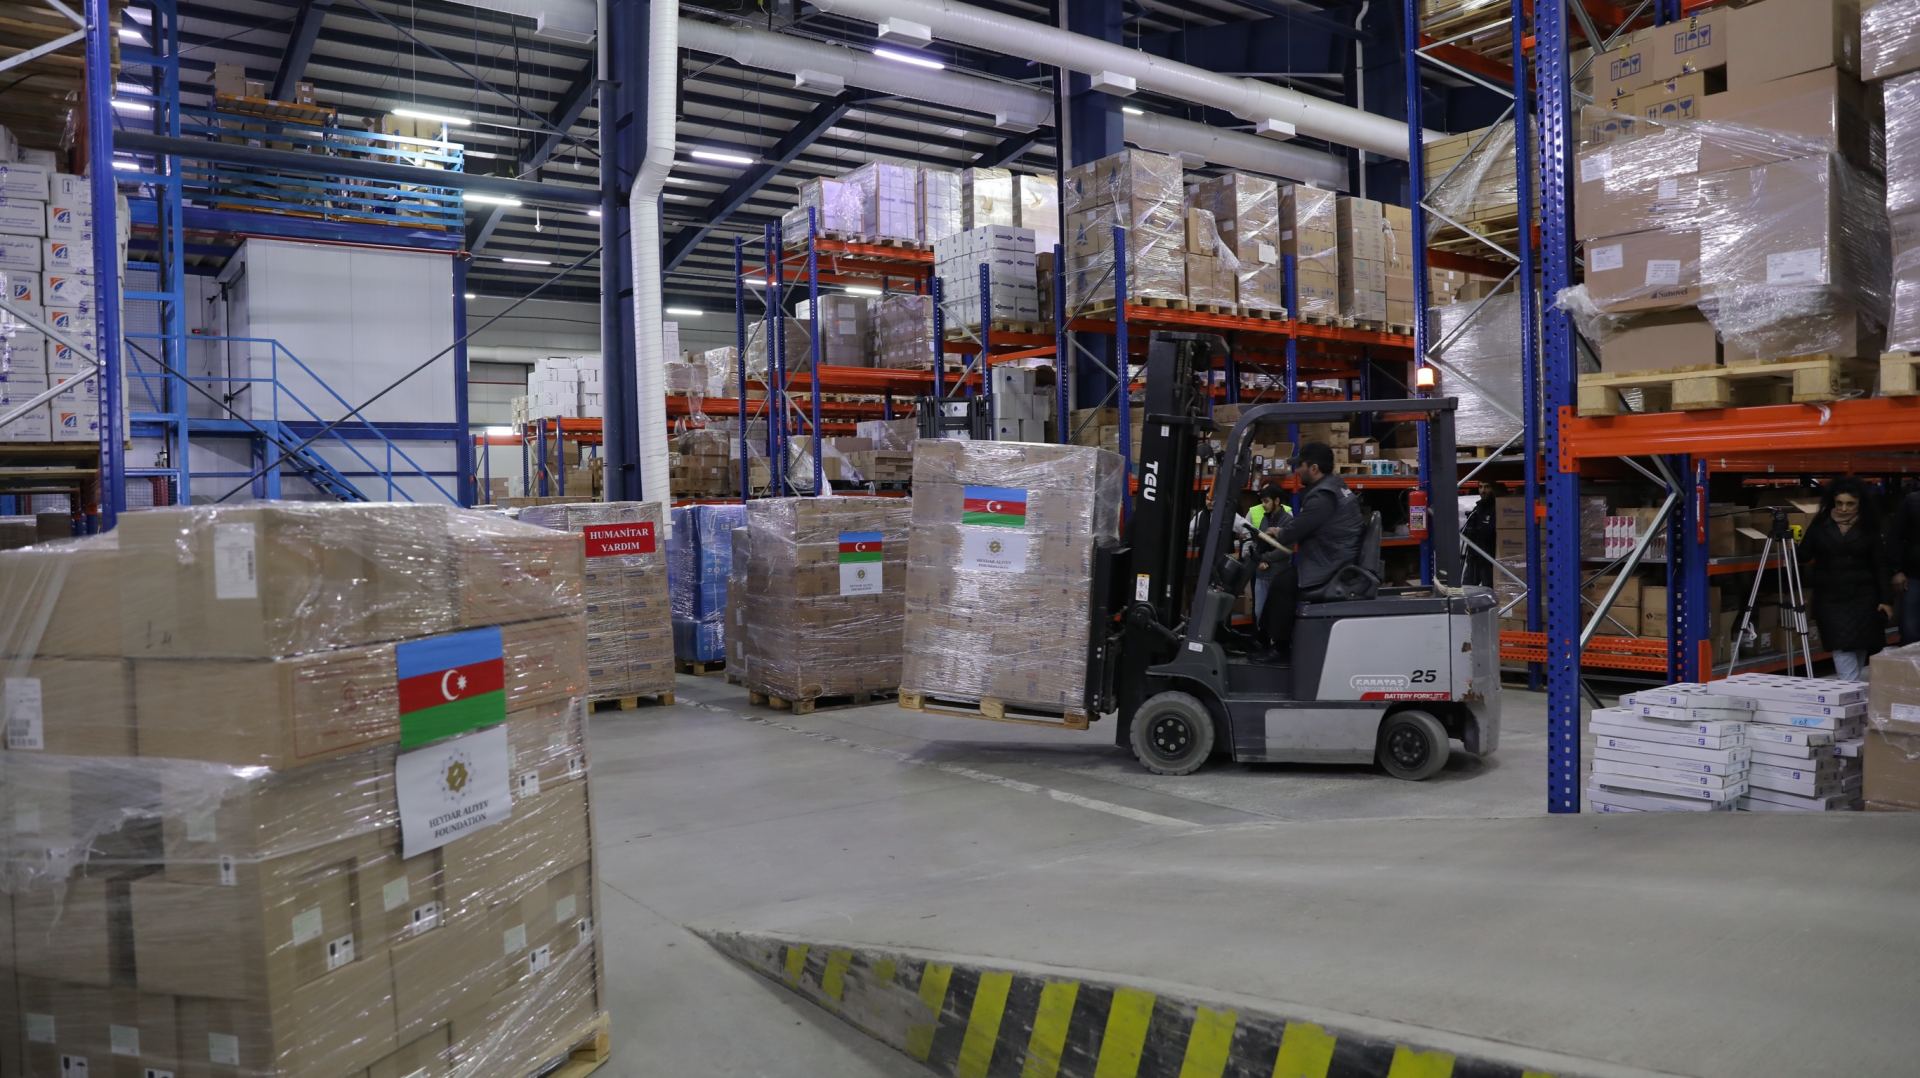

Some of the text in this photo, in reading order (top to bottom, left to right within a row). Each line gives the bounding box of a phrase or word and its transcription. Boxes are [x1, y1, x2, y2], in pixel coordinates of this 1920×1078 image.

[590, 527, 649, 540] HUMANİTAR
[601, 542, 640, 552] YARDIM
[1410, 669, 1437, 683] 25
[429, 799, 488, 828] HEYDAR ALIYEV
[434, 813, 487, 838] FOUNDATION
